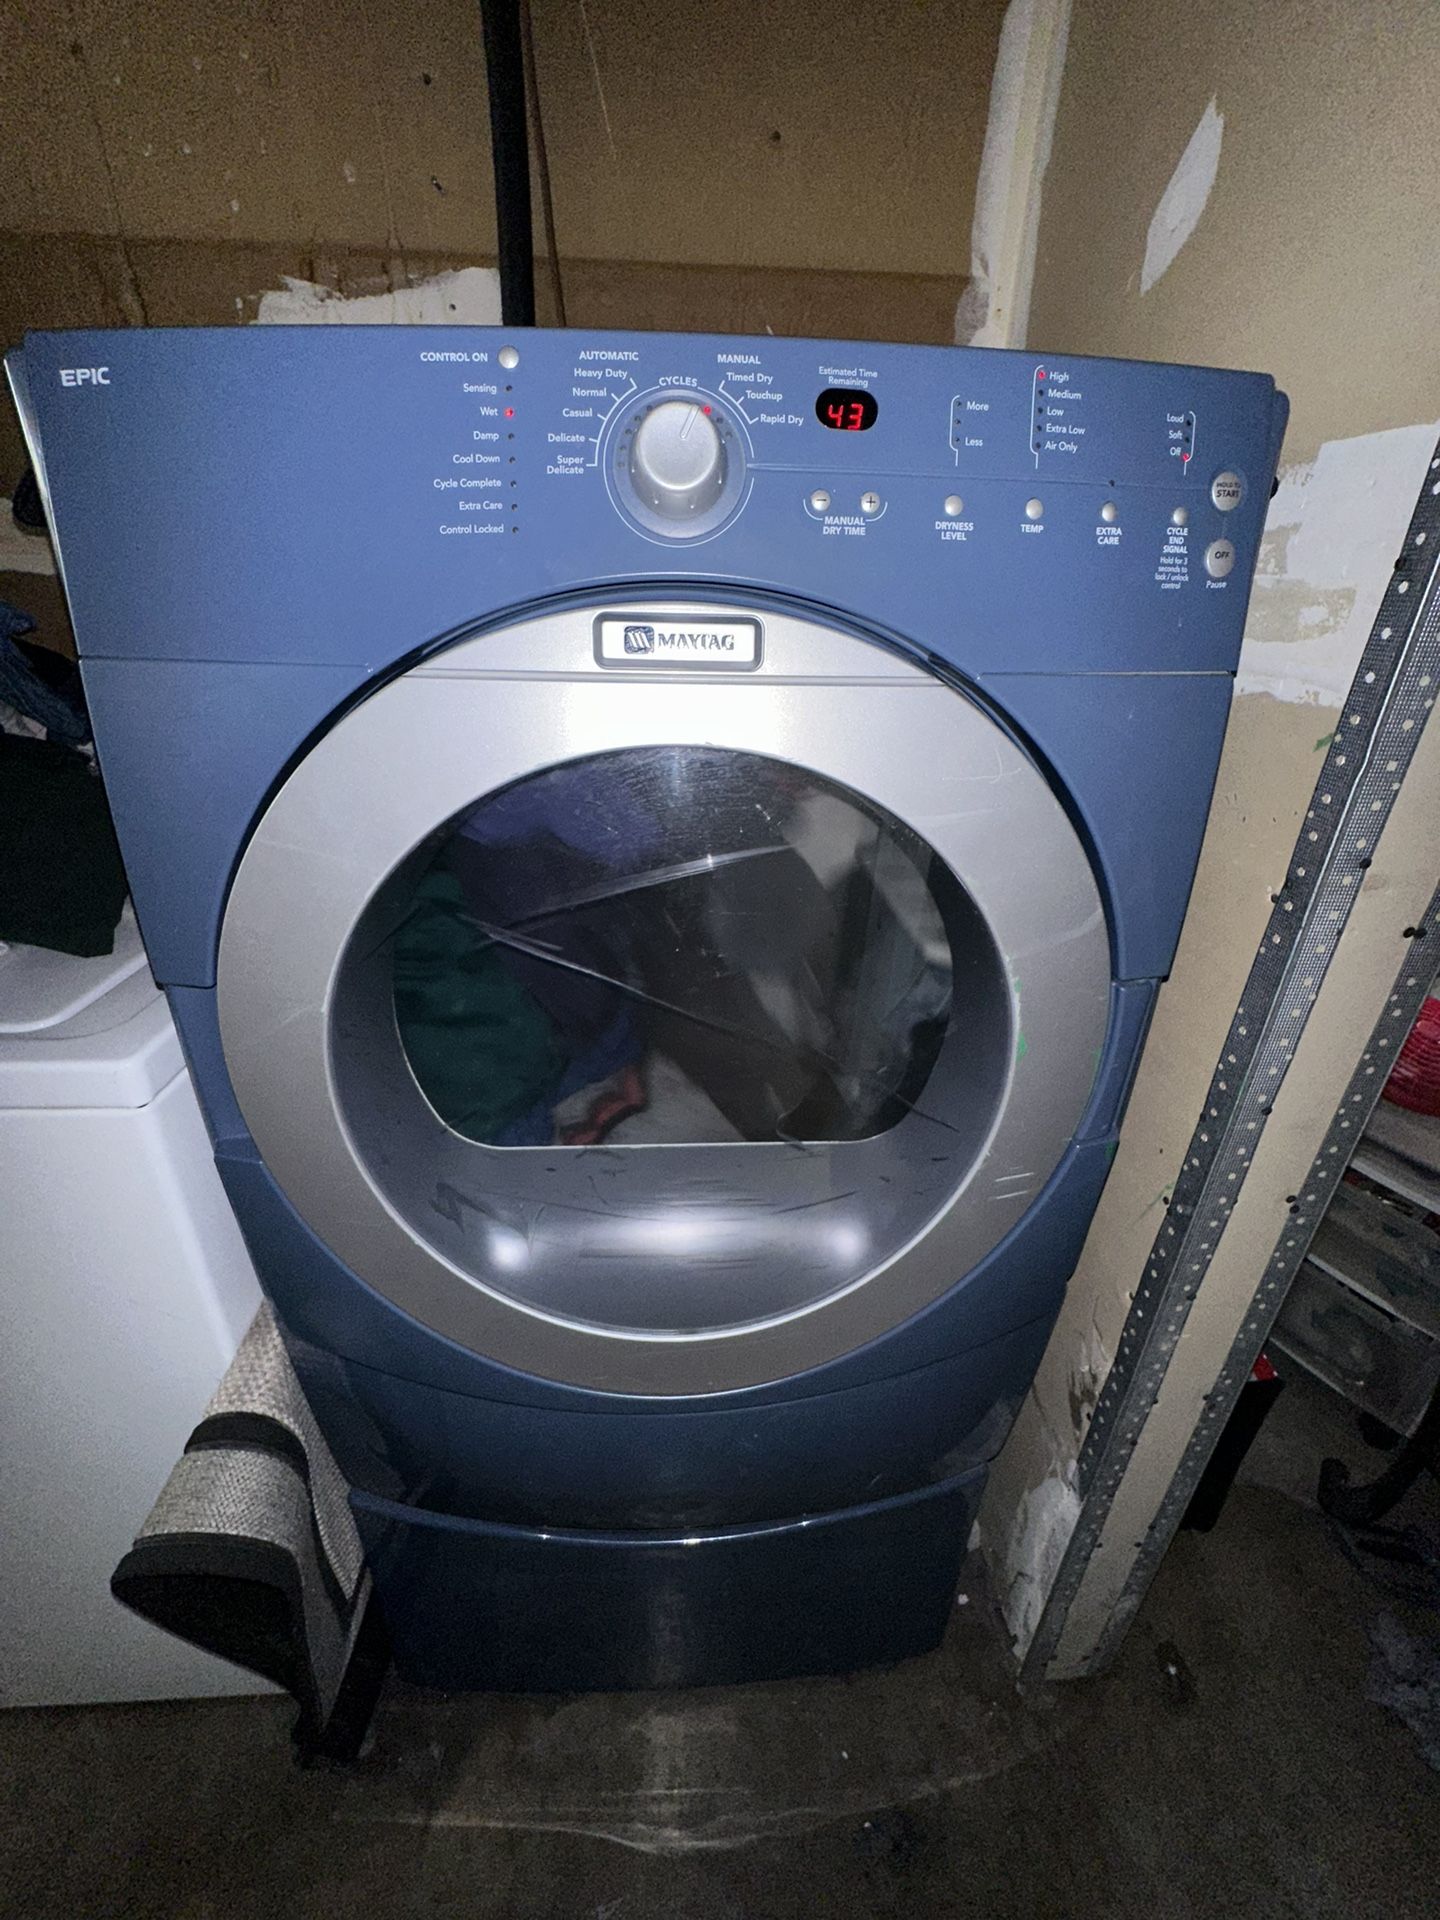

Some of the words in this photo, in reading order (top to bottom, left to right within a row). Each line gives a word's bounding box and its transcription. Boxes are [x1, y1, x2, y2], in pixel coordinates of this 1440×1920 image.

[421, 353, 470, 361] CONTROL
[472, 353, 488, 361] ON
[579, 351, 639, 360] AUTOMATIC
[718, 354, 760, 364] MANUAL
[60, 367, 110, 386] EPIC
[574, 369, 603, 378] Heavy
[605, 369, 627, 379] Duty
[819, 367, 857, 377] Estimated
[859, 369, 877, 377] Time
[727, 373, 754, 382] Timed
[757, 374, 773, 384] Dry
[1050, 372, 1069, 382] High
[659, 377, 697, 387] CYCLES
[829, 377, 868, 388] Remaining
[464, 384, 497, 394] Sensing
[572, 388, 606, 397] Normal
[746, 391, 782, 401] Touchup
[1048, 390, 1081, 399] Medium
[967, 402, 989, 411] More
[480, 407, 498, 416] Wet
[563, 409, 592, 417] Casual
[1047, 407, 1064, 416] Low
[760, 414, 785, 424] Rapid
[788, 415, 804, 425] Dry
[828, 404, 863, 430] 43
[1167, 413, 1184, 422] Loud
[1046, 425, 1066, 434] Extra
[1069, 426, 1085, 435] Low
[474, 431, 499, 442] Damp
[548, 434, 585, 442] Delicate
[1169, 431, 1182, 439] Soft
[965, 438, 983, 446] Less
[1045, 442, 1058, 450] Air
[1060, 443, 1078, 453] Only
[1170, 447, 1181, 455] Off
[453, 455, 473, 463] Cool
[475, 455, 500, 463] Down
[557, 456, 584, 465] Super
[547, 466, 584, 474] Delicate
[434, 479, 458, 490] Cycle
[461, 478, 501, 488] Complete
[1216, 490, 1239, 498] START
[459, 502, 481, 510] Extra
[483, 501, 502, 510] Care
[825, 516, 865, 525] MANUAL
[440, 525, 472, 534] Control
[474, 525, 504, 534] Locked
[823, 526, 841, 535] DRY
[843, 527, 865, 535] TIME
[935, 521, 973, 531] DRYNESS
[1021, 524, 1043, 533] TEMP
[1096, 527, 1122, 536] EXTRA
[1167, 528, 1188, 536] CYCLE
[941, 532, 967, 541] LEVEL
[1098, 537, 1119, 545] CARE
[1169, 537, 1184, 545] END
[1163, 545, 1187, 554] SIGNAL
[1215, 551, 1229, 559] OFF
[658, 633, 734, 650] MAYTAG
